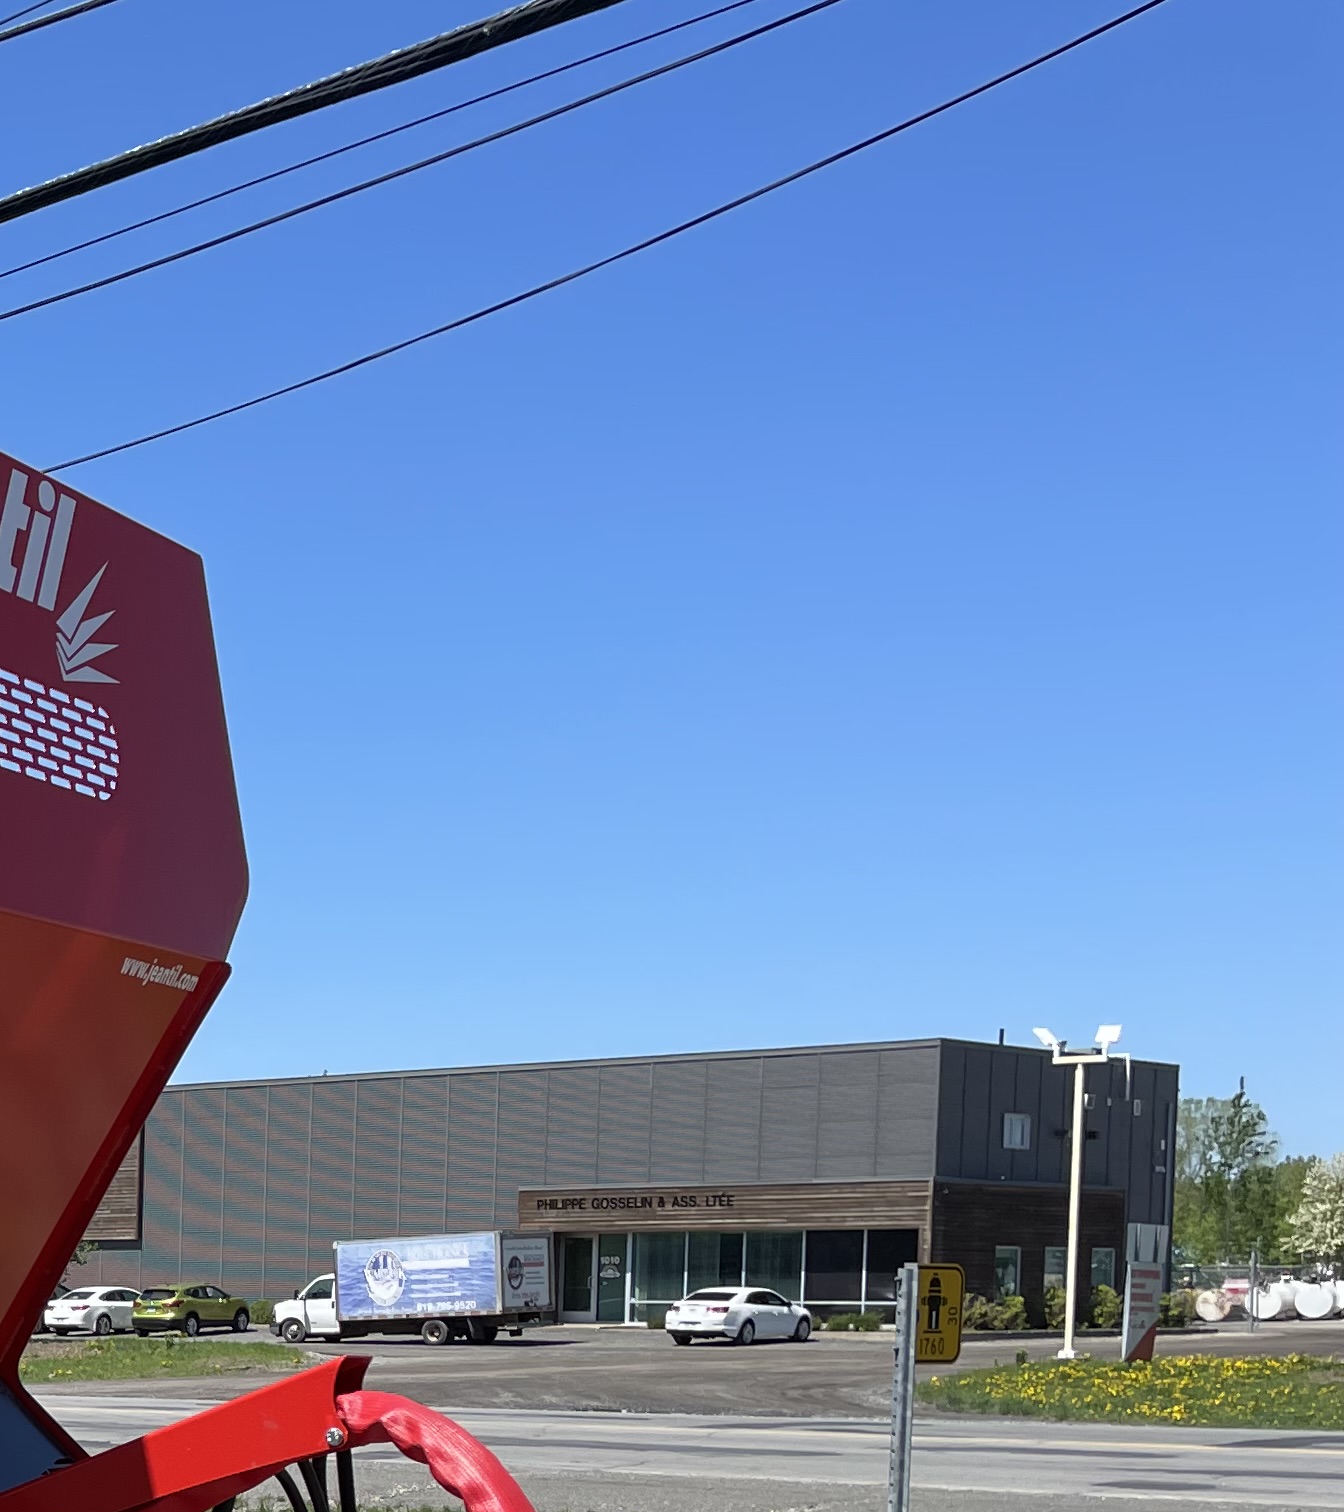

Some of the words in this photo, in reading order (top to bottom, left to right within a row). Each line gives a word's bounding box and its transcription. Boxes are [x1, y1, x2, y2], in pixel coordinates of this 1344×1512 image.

[120, 956, 200, 993] www.jeantil.com
[536, 1198, 587, 1211] PHILIPPE
[591, 1196, 653, 1210] GOSSELIN
[657, 1196, 666, 1208] &
[671, 1195, 701, 1208] ASS.
[705, 1193, 736, 1207] LTÉE
[947, 1306, 958, 1326] 30
[919, 1338, 945, 1355] 1760
